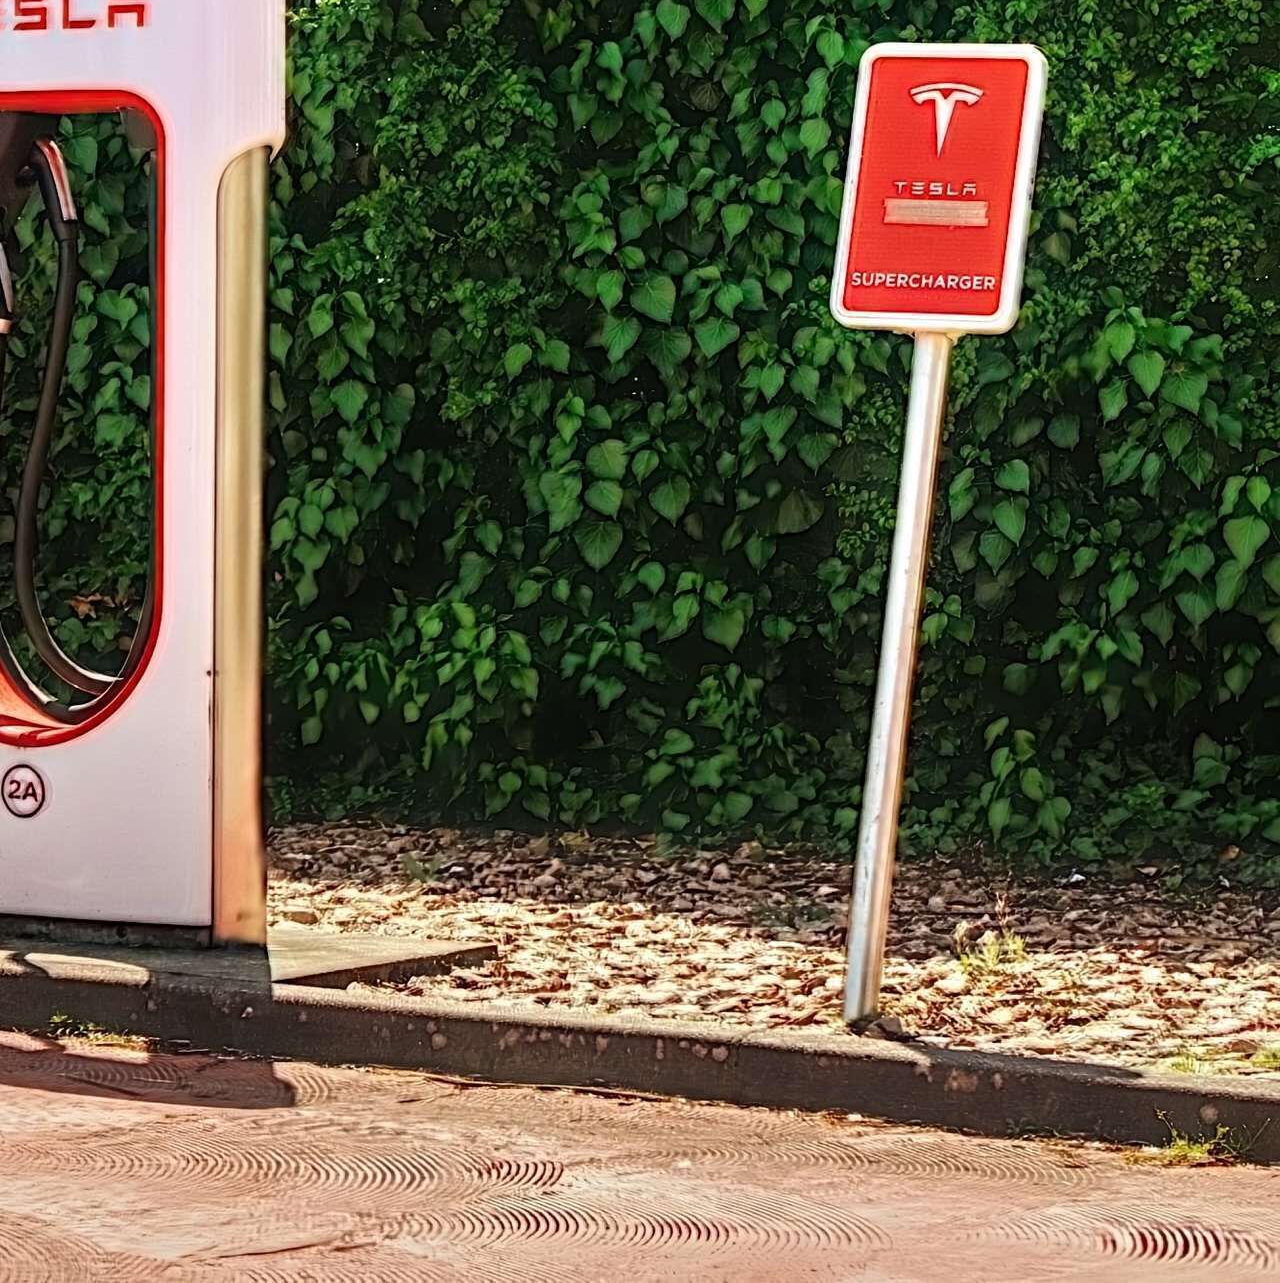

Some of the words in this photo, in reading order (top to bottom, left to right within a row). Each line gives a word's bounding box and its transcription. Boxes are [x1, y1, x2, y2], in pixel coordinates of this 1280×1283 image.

[894, 181, 978, 196] TESLA
[851, 272, 996, 291] SUPERCHARGER
[8, 780, 38, 803] 2A
